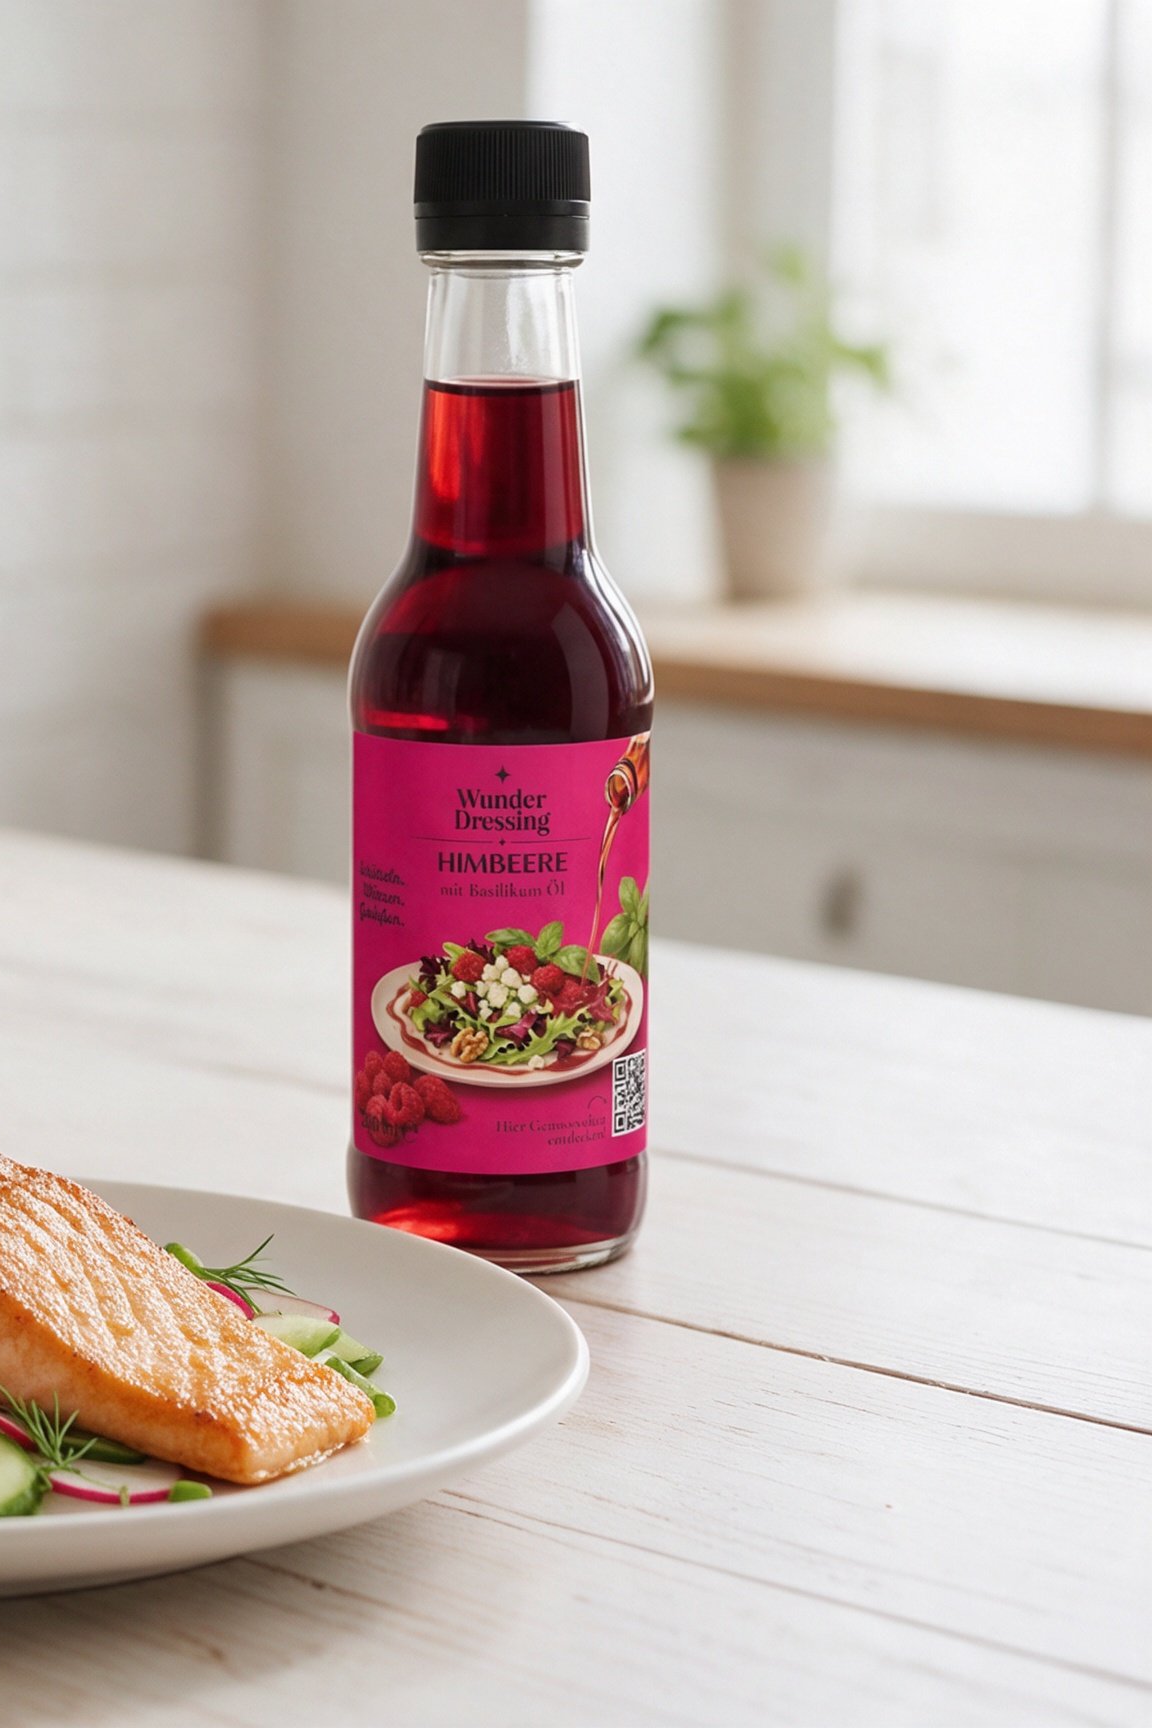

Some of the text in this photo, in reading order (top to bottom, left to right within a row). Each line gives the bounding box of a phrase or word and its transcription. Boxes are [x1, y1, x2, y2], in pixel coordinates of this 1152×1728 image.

[456, 788, 547, 810] Wunder
[455, 809, 551, 836] Dressing
[438, 852, 567, 874] HIMBEERE
[440, 879, 565, 897] mit Basilikum Öl
[496, 1120, 526, 1133] Hier
